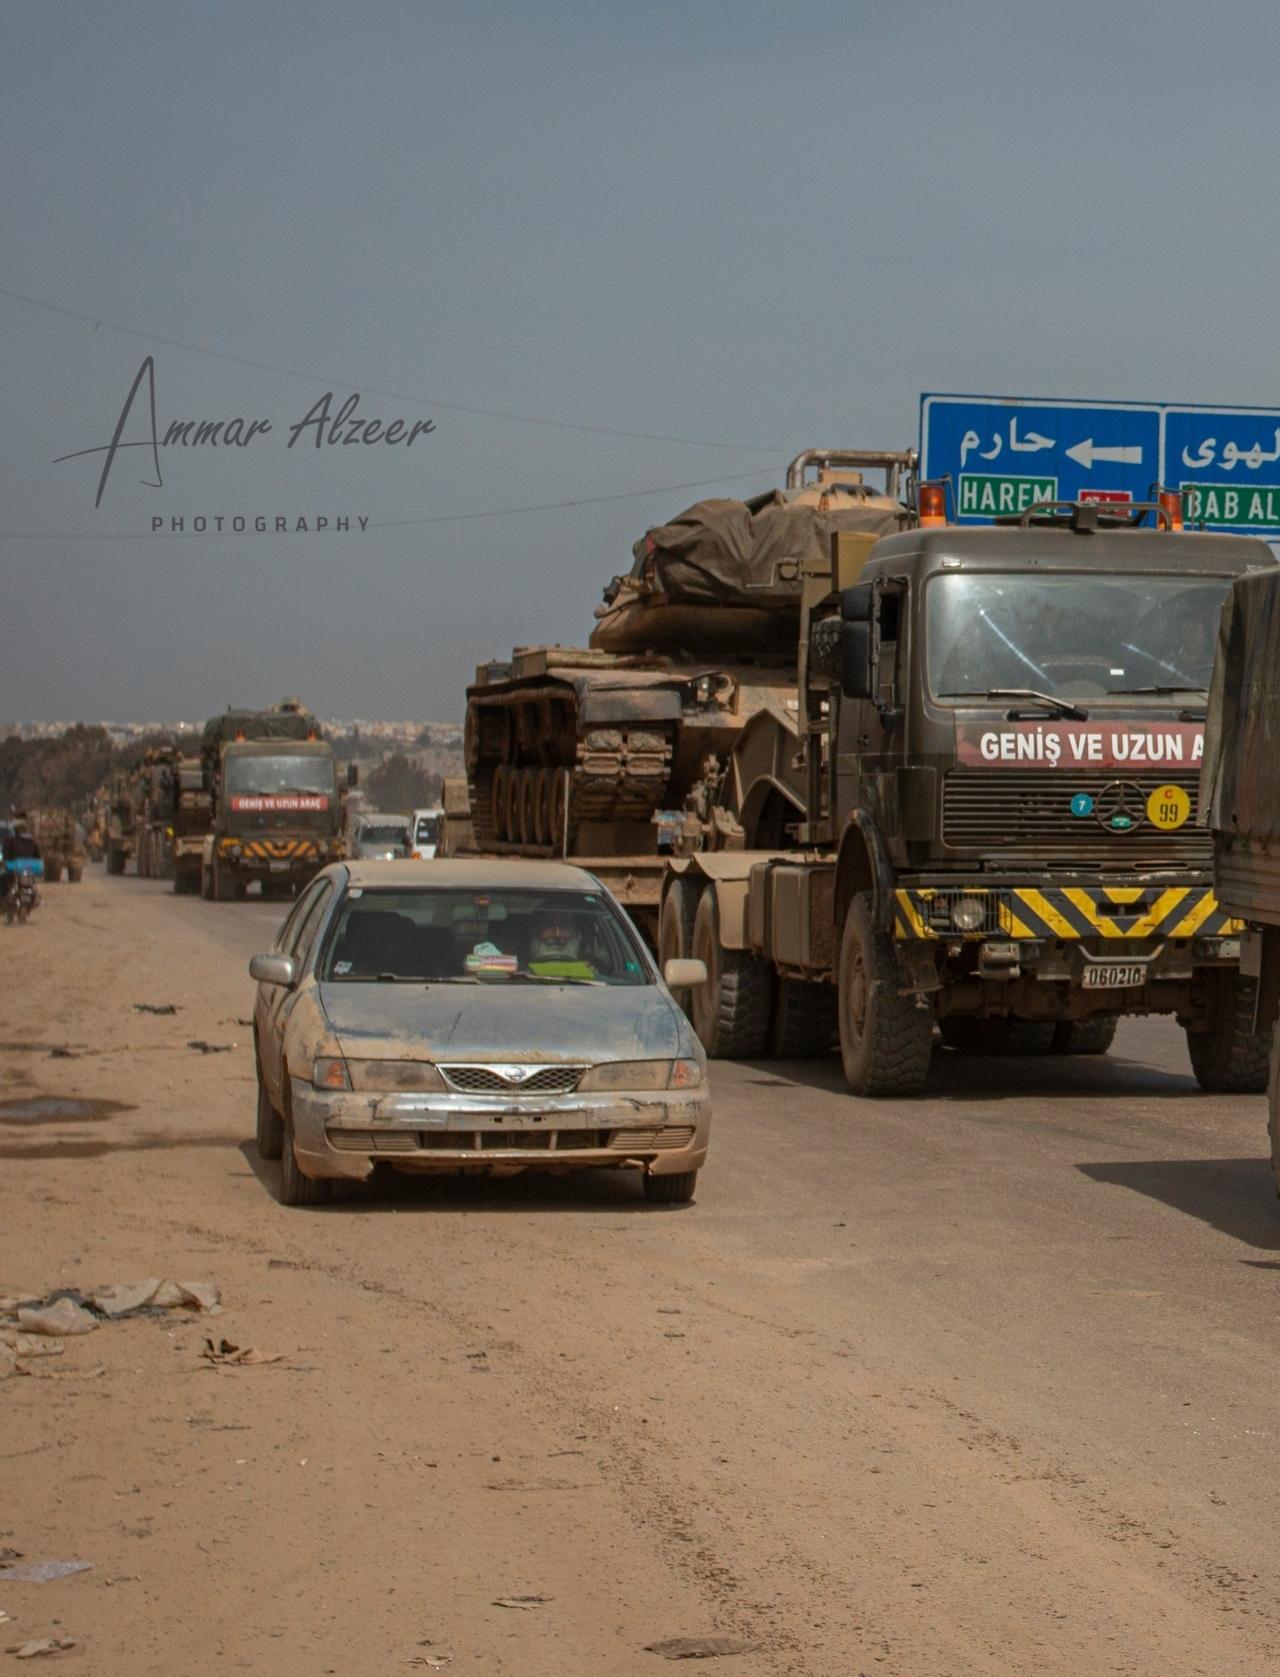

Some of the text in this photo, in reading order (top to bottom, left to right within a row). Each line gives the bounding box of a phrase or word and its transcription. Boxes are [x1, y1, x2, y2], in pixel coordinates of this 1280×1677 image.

[960, 416, 1057, 469] حارم
[963, 480, 1053, 513] HAREM
[1187, 490, 1239, 520] BAB
[980, 726, 1061, 768] GENİŞ
[1069, 733, 1103, 760] VE
[1111, 733, 1183, 761] UZUN
[1078, 800, 1086, 811] 7
[1164, 789, 1173, 799] C
[1159, 803, 1178, 823] 99
